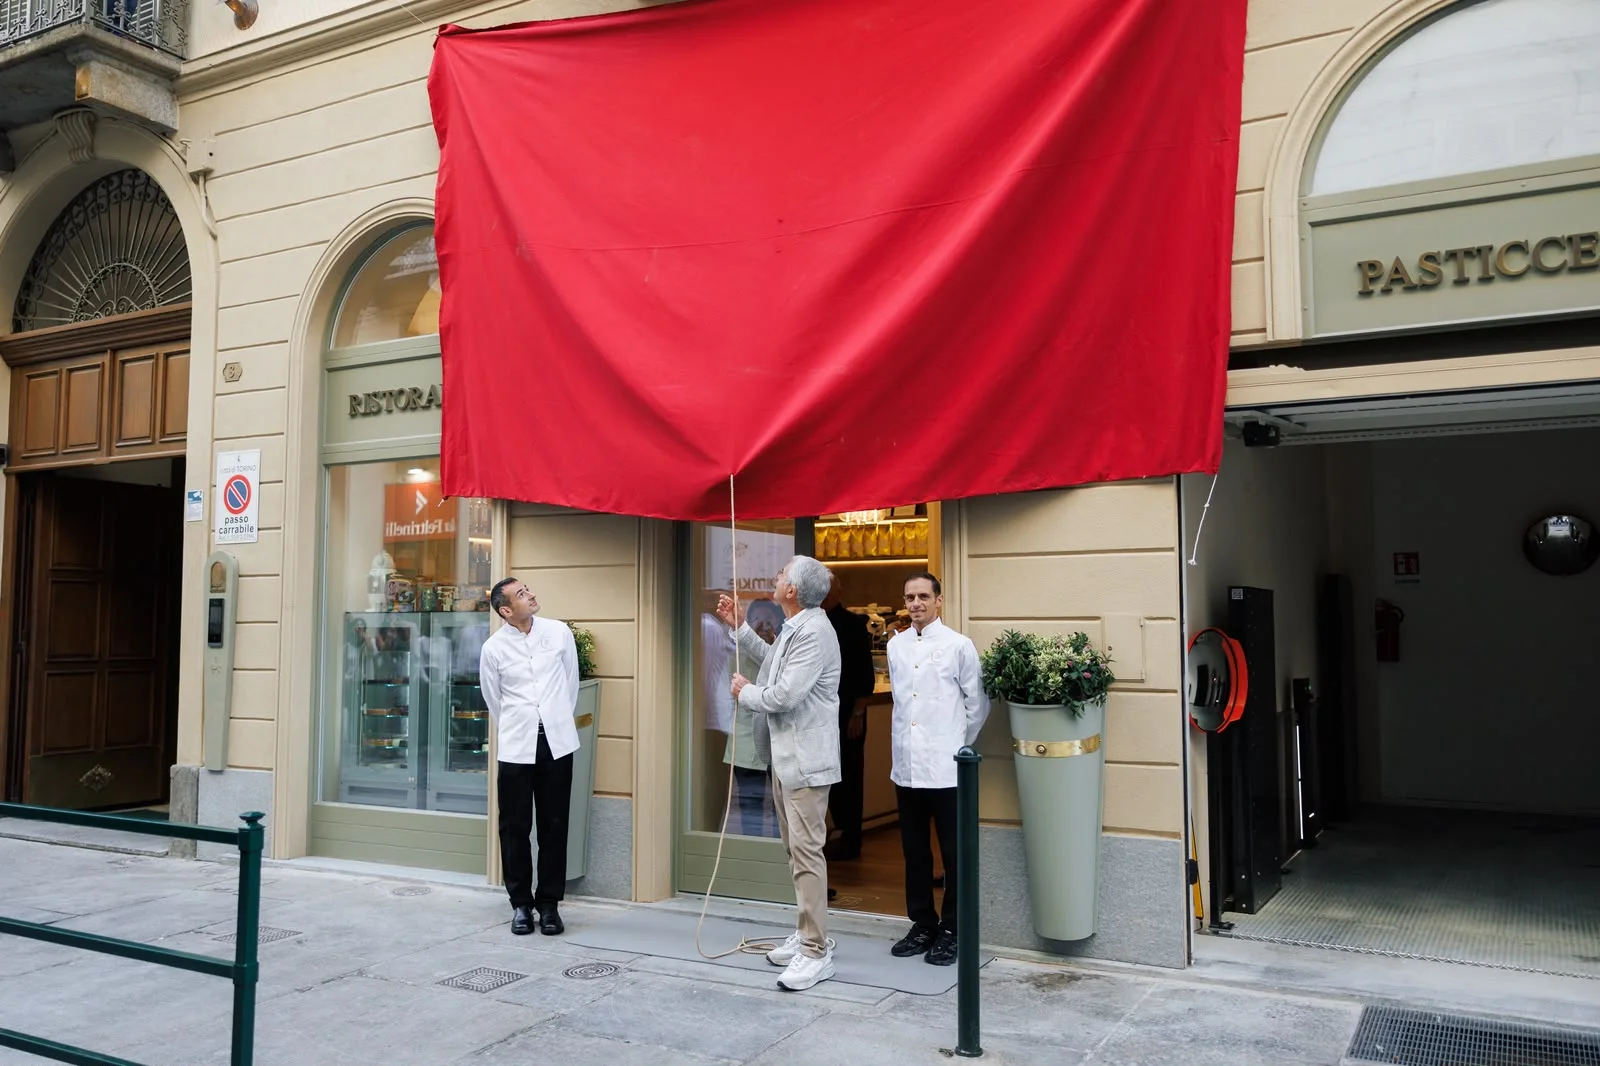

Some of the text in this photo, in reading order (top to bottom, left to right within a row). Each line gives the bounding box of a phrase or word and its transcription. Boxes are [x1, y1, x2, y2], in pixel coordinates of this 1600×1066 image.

[1357, 231, 1600, 295] PASTICCE
[348, 384, 442, 418] RISTORA
[218, 524, 255, 534] carrabile
[225, 516, 249, 526] passo
